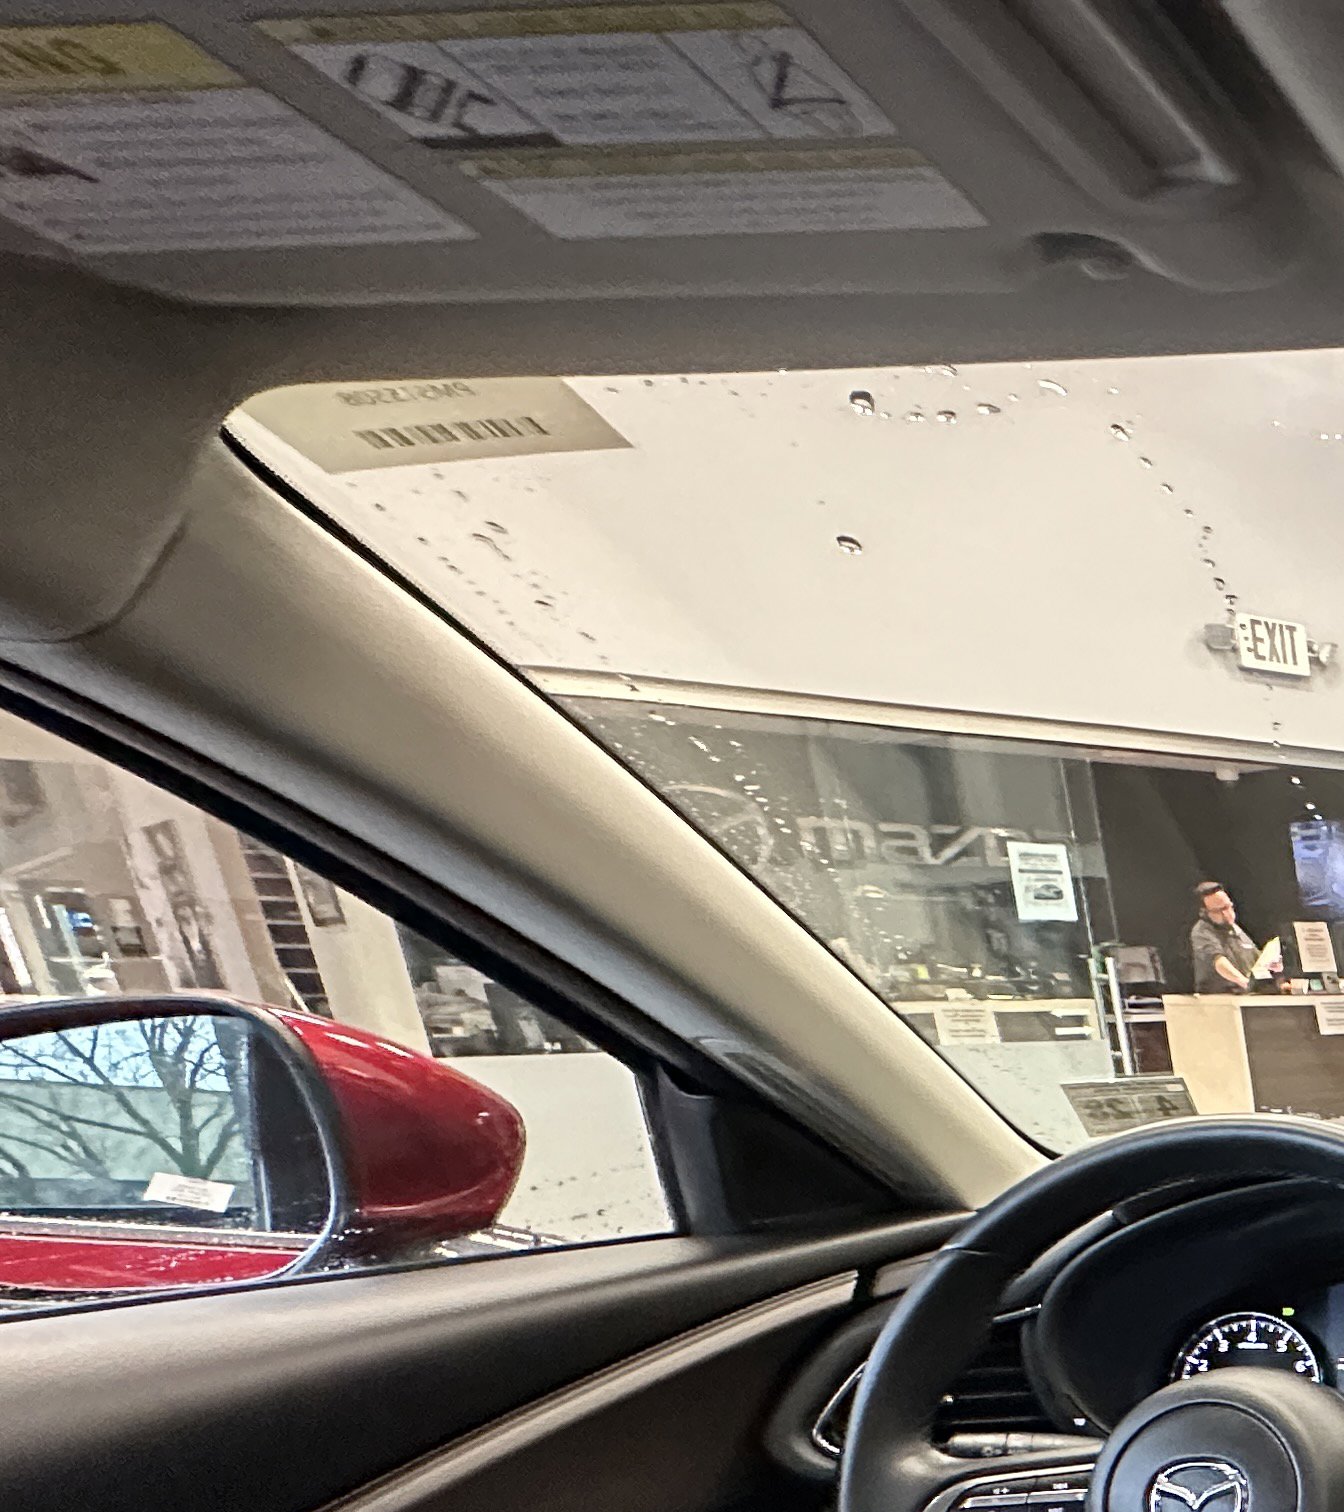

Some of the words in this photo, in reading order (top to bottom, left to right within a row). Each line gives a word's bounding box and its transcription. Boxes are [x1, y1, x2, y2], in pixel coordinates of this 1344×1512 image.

[1250, 618, 1298, 666] EXIT
[1217, 1339, 1230, 1353] 3
[1276, 1339, 1288, 1353] 5
[1197, 1359, 1209, 1372] 2
[1294, 1359, 1307, 1373] 6
